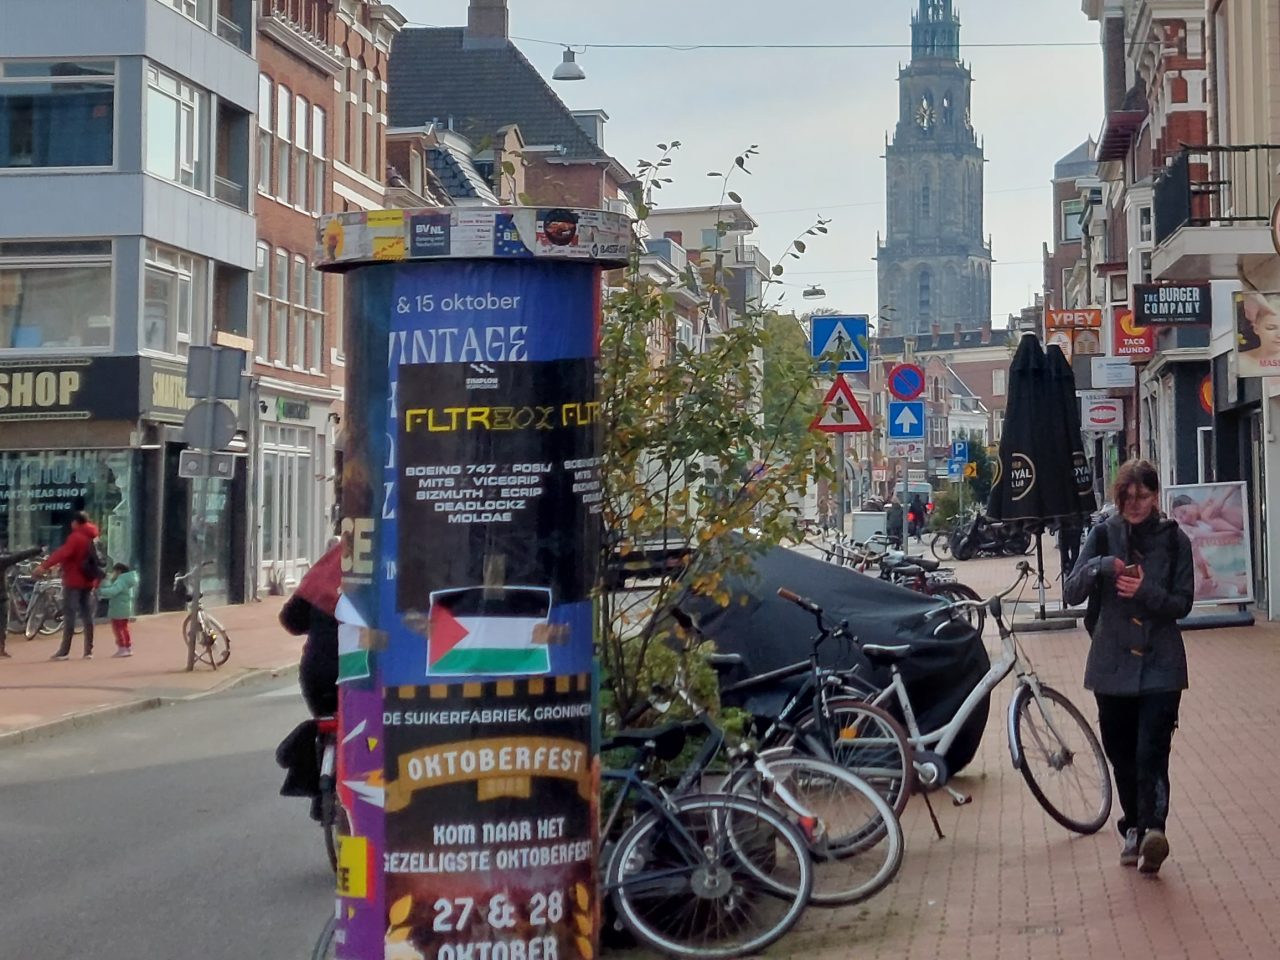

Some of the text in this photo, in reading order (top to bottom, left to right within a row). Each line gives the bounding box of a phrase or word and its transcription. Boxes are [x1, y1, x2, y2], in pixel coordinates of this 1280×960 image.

[1143, 287, 1200, 303] THE BURGER
[396, 292, 520, 314] & 15 oktober
[1143, 301, 1200, 315] COMPANY
[1051, 312, 1096, 326] YPEY
[1122, 338, 1146, 346] TACO
[1118, 346, 1151, 355] MUNDO
[405, 466, 462, 476] BOEING
[465, 464, 496, 474] 747
[1011, 468, 1033, 480] YAL
[418, 475, 540, 487] MITS VICEGRIP
[415, 490, 484, 501] BIZMUTH
[16, 502, 71, 512] CLOTHING
[434, 500, 526, 512] DEADLOCKZ
[382, 712, 401, 726] DE
[404, 707, 532, 725] SUIKERFABRIEK,
[407, 746, 583, 781] OKTOBERFEST
[432, 817, 566, 846] KOM NAAR HET
[433, 890, 564, 933] 27 & 28
[437, 937, 560, 960] OKTOBER
